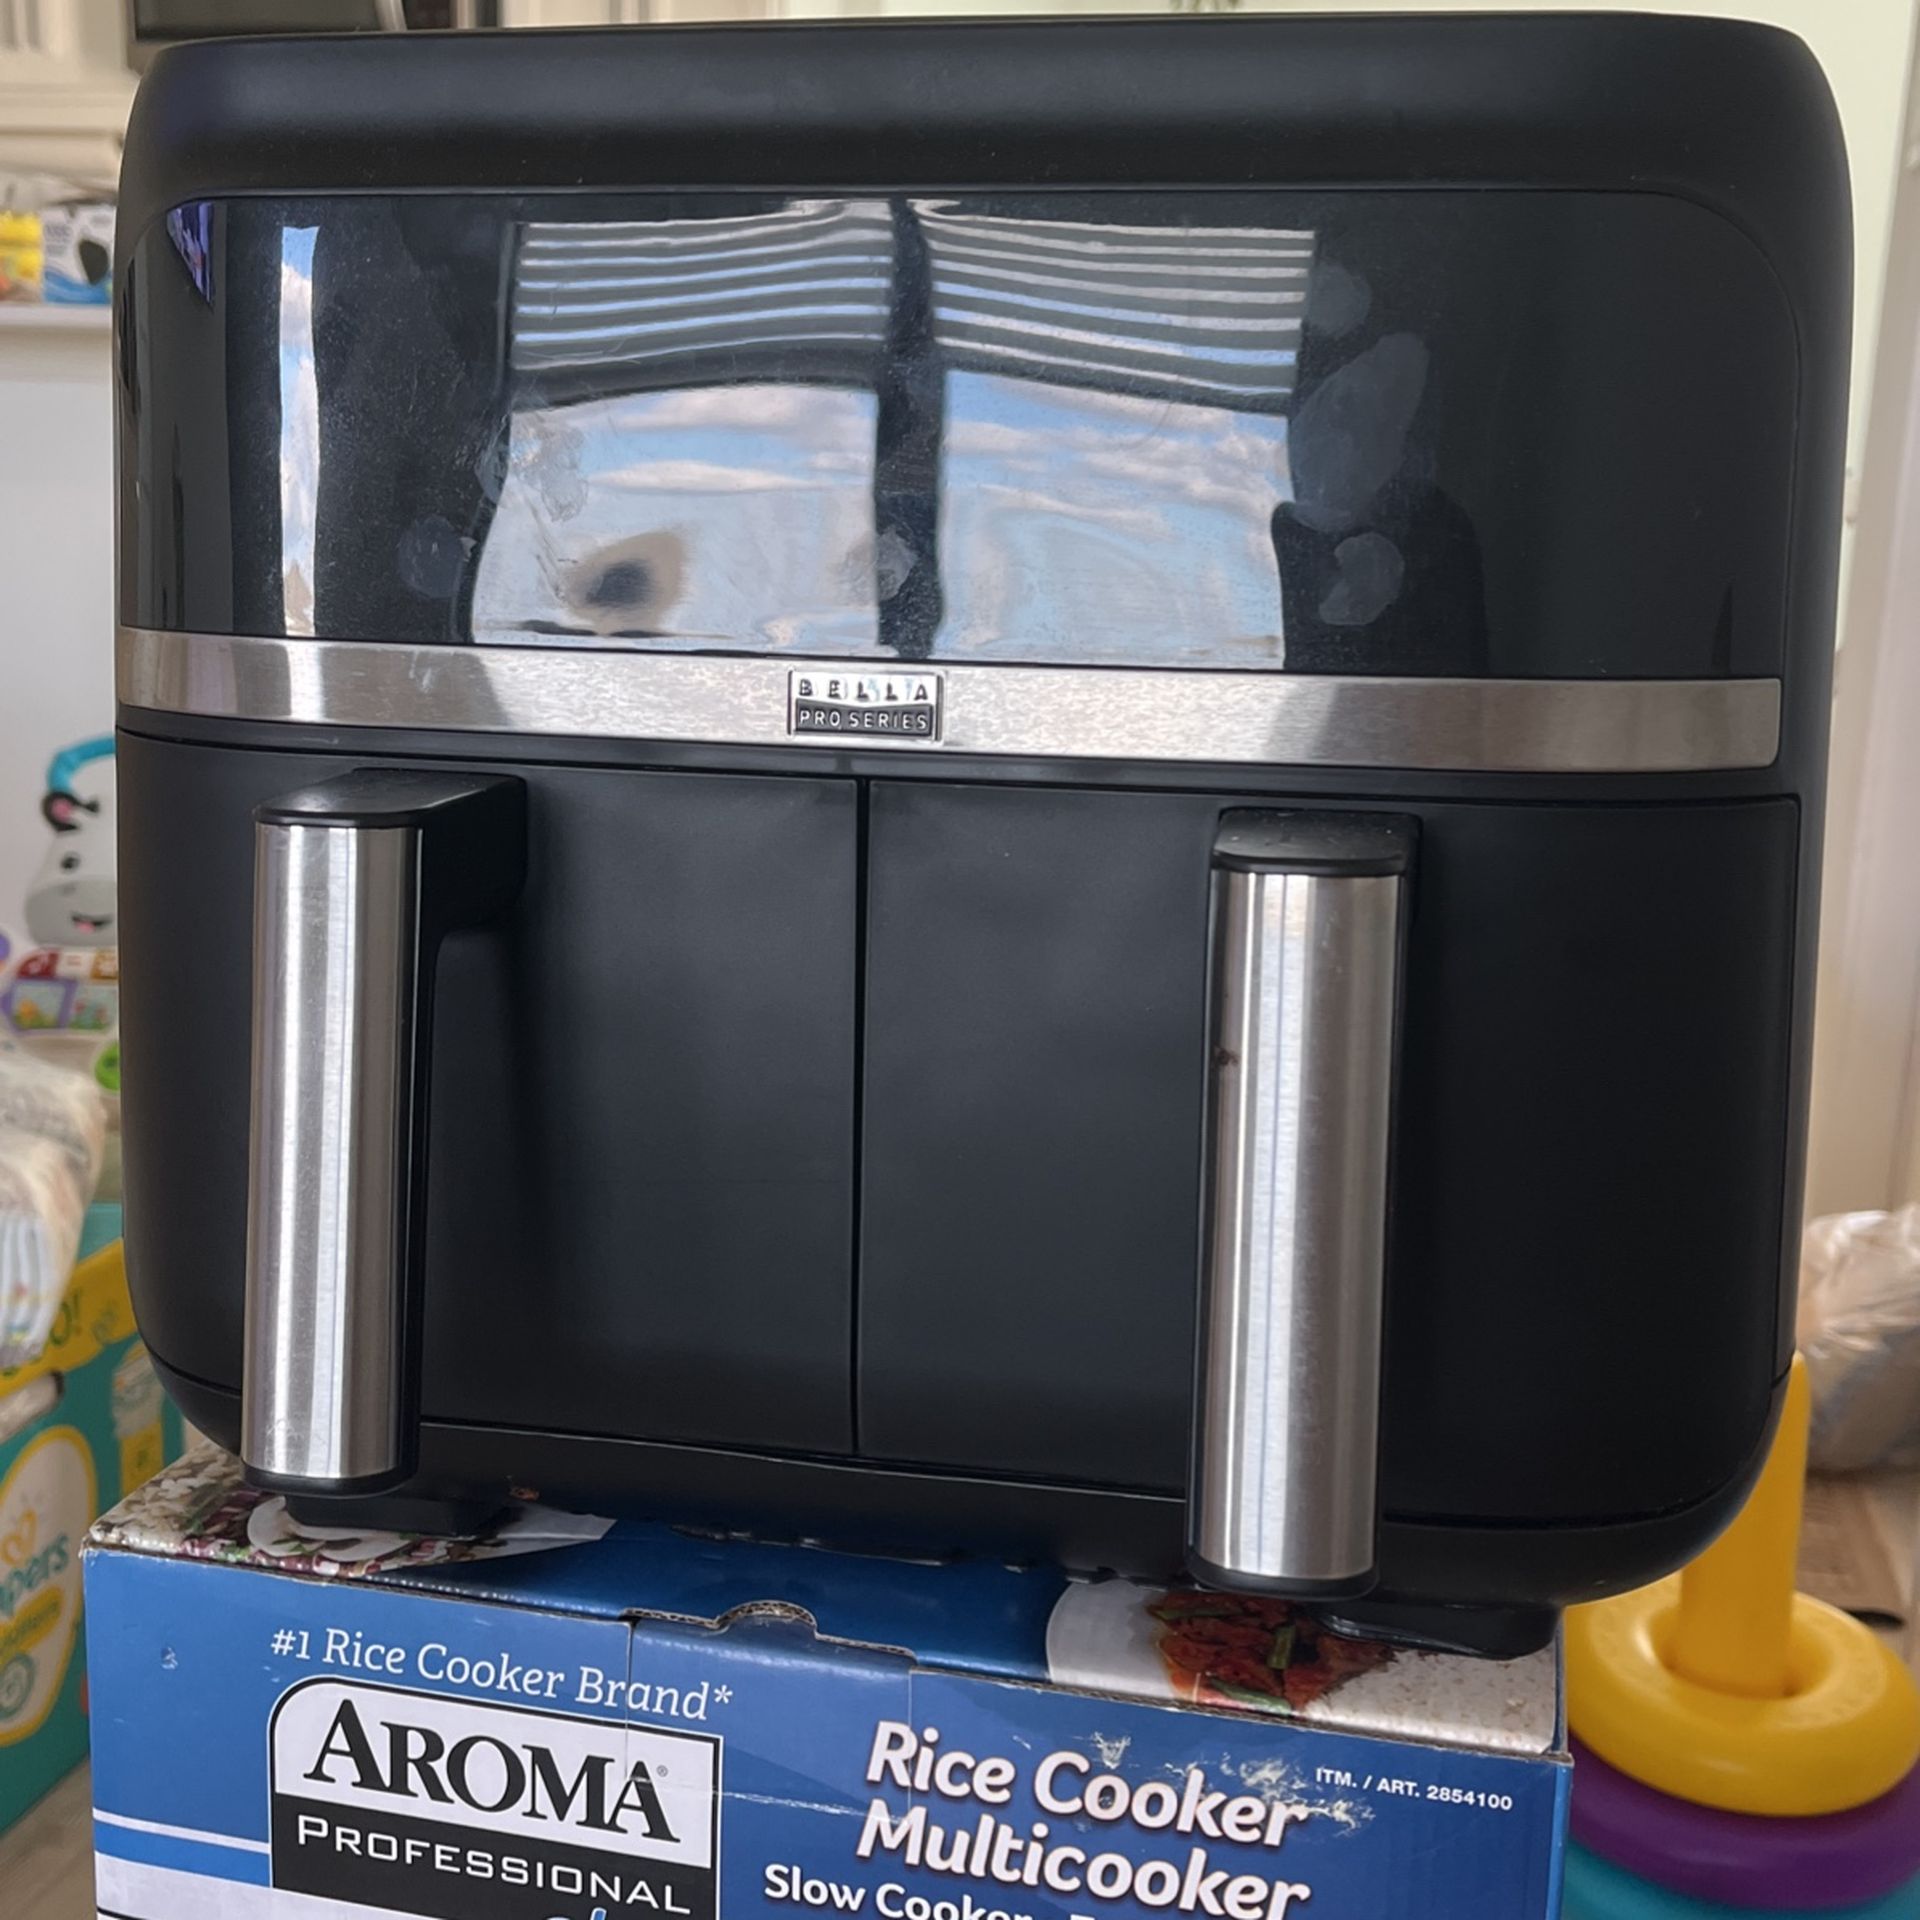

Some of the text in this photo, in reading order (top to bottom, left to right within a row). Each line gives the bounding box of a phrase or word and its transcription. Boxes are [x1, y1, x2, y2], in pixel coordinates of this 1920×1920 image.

[798, 678, 929, 701] BELLA
[799, 709, 928, 731] PRO SERIES
[271, 1628, 311, 1660] #1
[323, 1627, 406, 1674] Rice
[417, 1643, 565, 1698] Cooker
[303, 1698, 681, 1843] AROMA
[866, 1720, 1308, 1847] Rice Cooker
[1315, 1767, 1514, 1811] ITM. / ART. 2854100
[297, 1814, 691, 1915] PROFESSIONAL
[764, 1863, 1033, 1920] Slow Cook
[855, 1798, 1312, 1920] Multicooker
